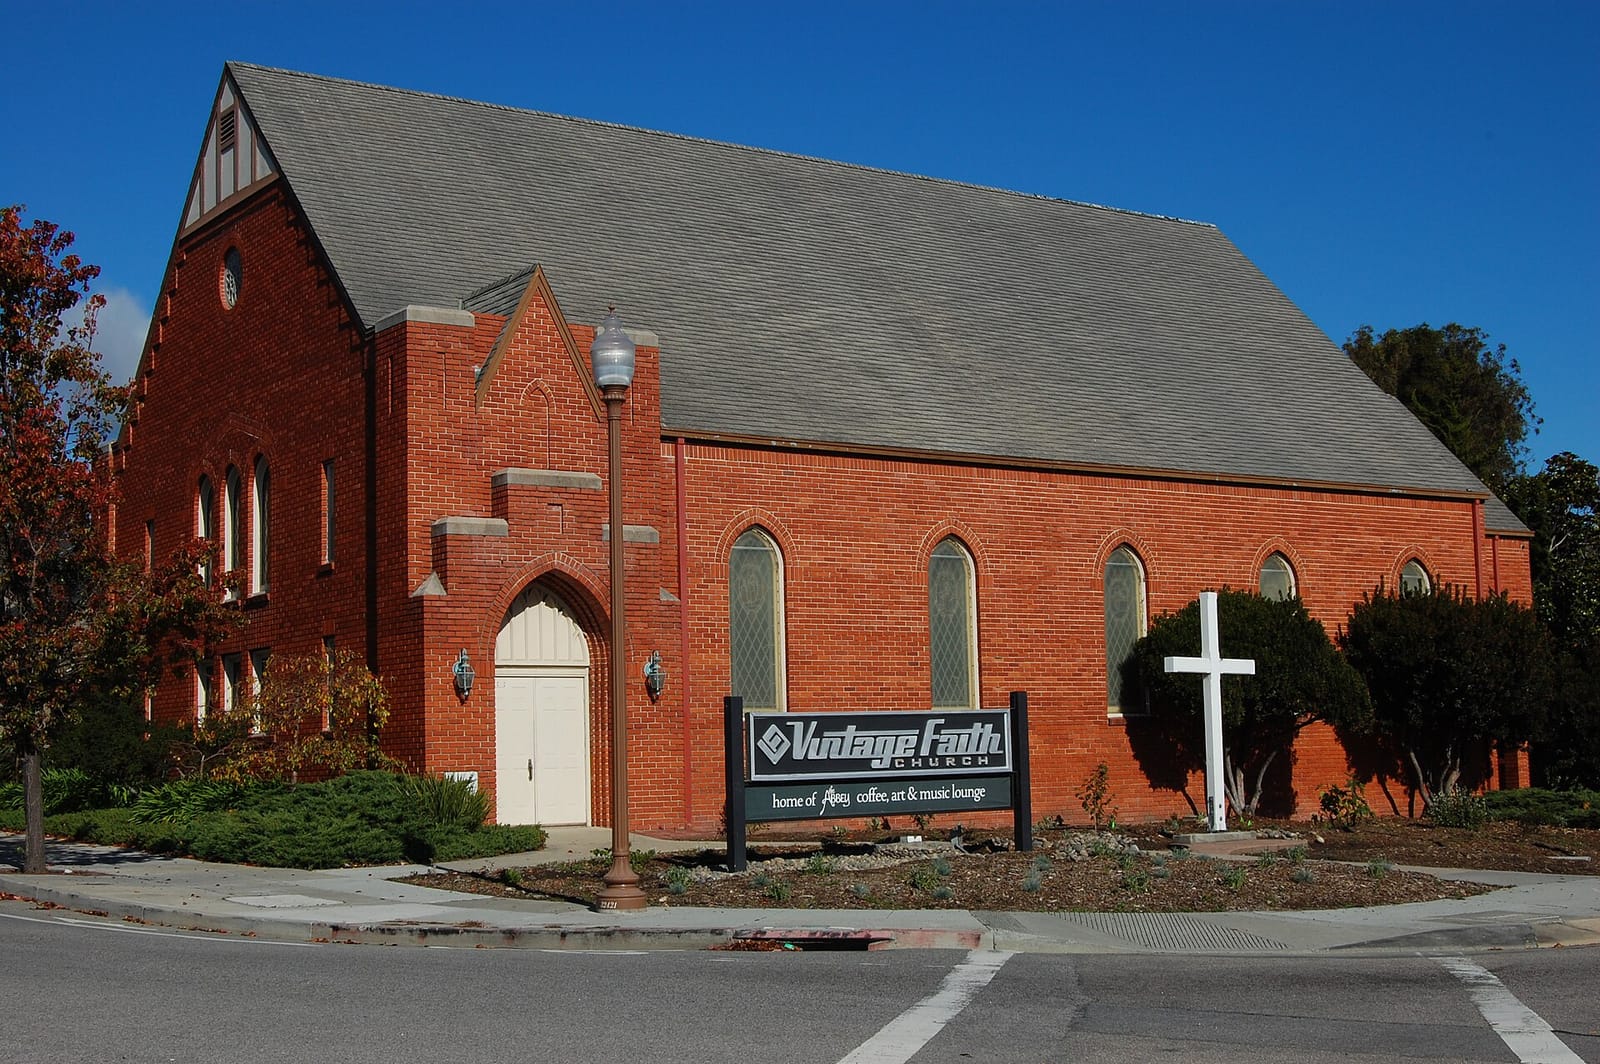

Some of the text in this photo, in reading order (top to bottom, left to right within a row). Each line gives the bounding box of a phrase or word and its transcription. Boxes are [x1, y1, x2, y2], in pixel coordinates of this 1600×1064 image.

[786, 718, 1004, 769] Vintage Faith
[894, 756, 989, 768] CHURCH
[772, 793, 804, 809] home
[805, 792, 817, 807] of
[857, 787, 889, 804] coffee,
[891, 788, 906, 801] art
[907, 786, 918, 801] &
[919, 785, 951, 800] music
[951, 783, 986, 800] lounge
